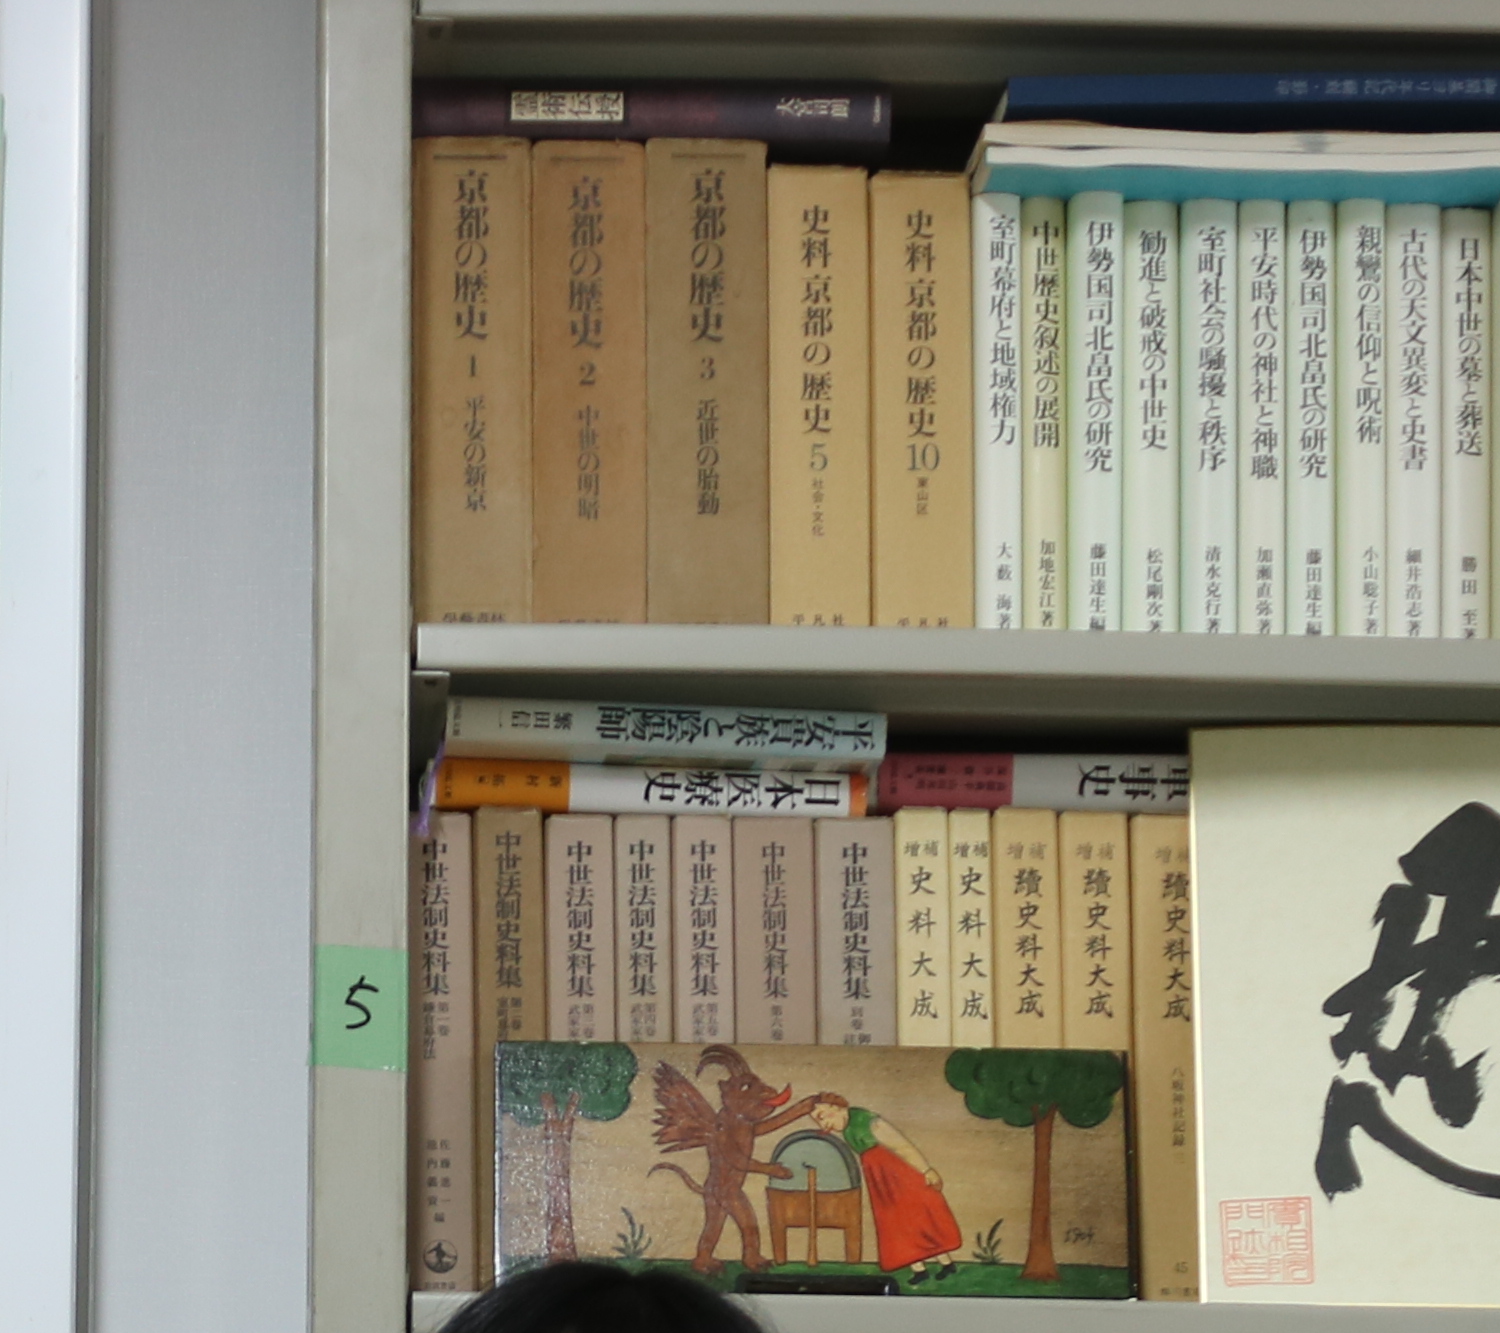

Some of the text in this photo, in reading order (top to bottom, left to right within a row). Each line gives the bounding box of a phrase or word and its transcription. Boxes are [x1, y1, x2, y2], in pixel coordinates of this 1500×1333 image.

[453, 169, 490, 341] 京都の歴史
[568, 174, 604, 387] 京都の歴史 2
[689, 167, 727, 343] 京都の歴史
[989, 216, 1017, 447] 室町幕府と地域権力
[1032, 221, 1060, 449] 中世歴史叙述の展開
[699, 356, 715, 380] 3
[1084, 220, 1114, 472] 伊勢国司北畠氏の研究
[1299, 228, 1328, 480] 伊勢国司北畠氏の研究
[809, 442, 828, 472] 5
[906, 442, 941, 472] 10
[345, 976, 380, 1031] 5
